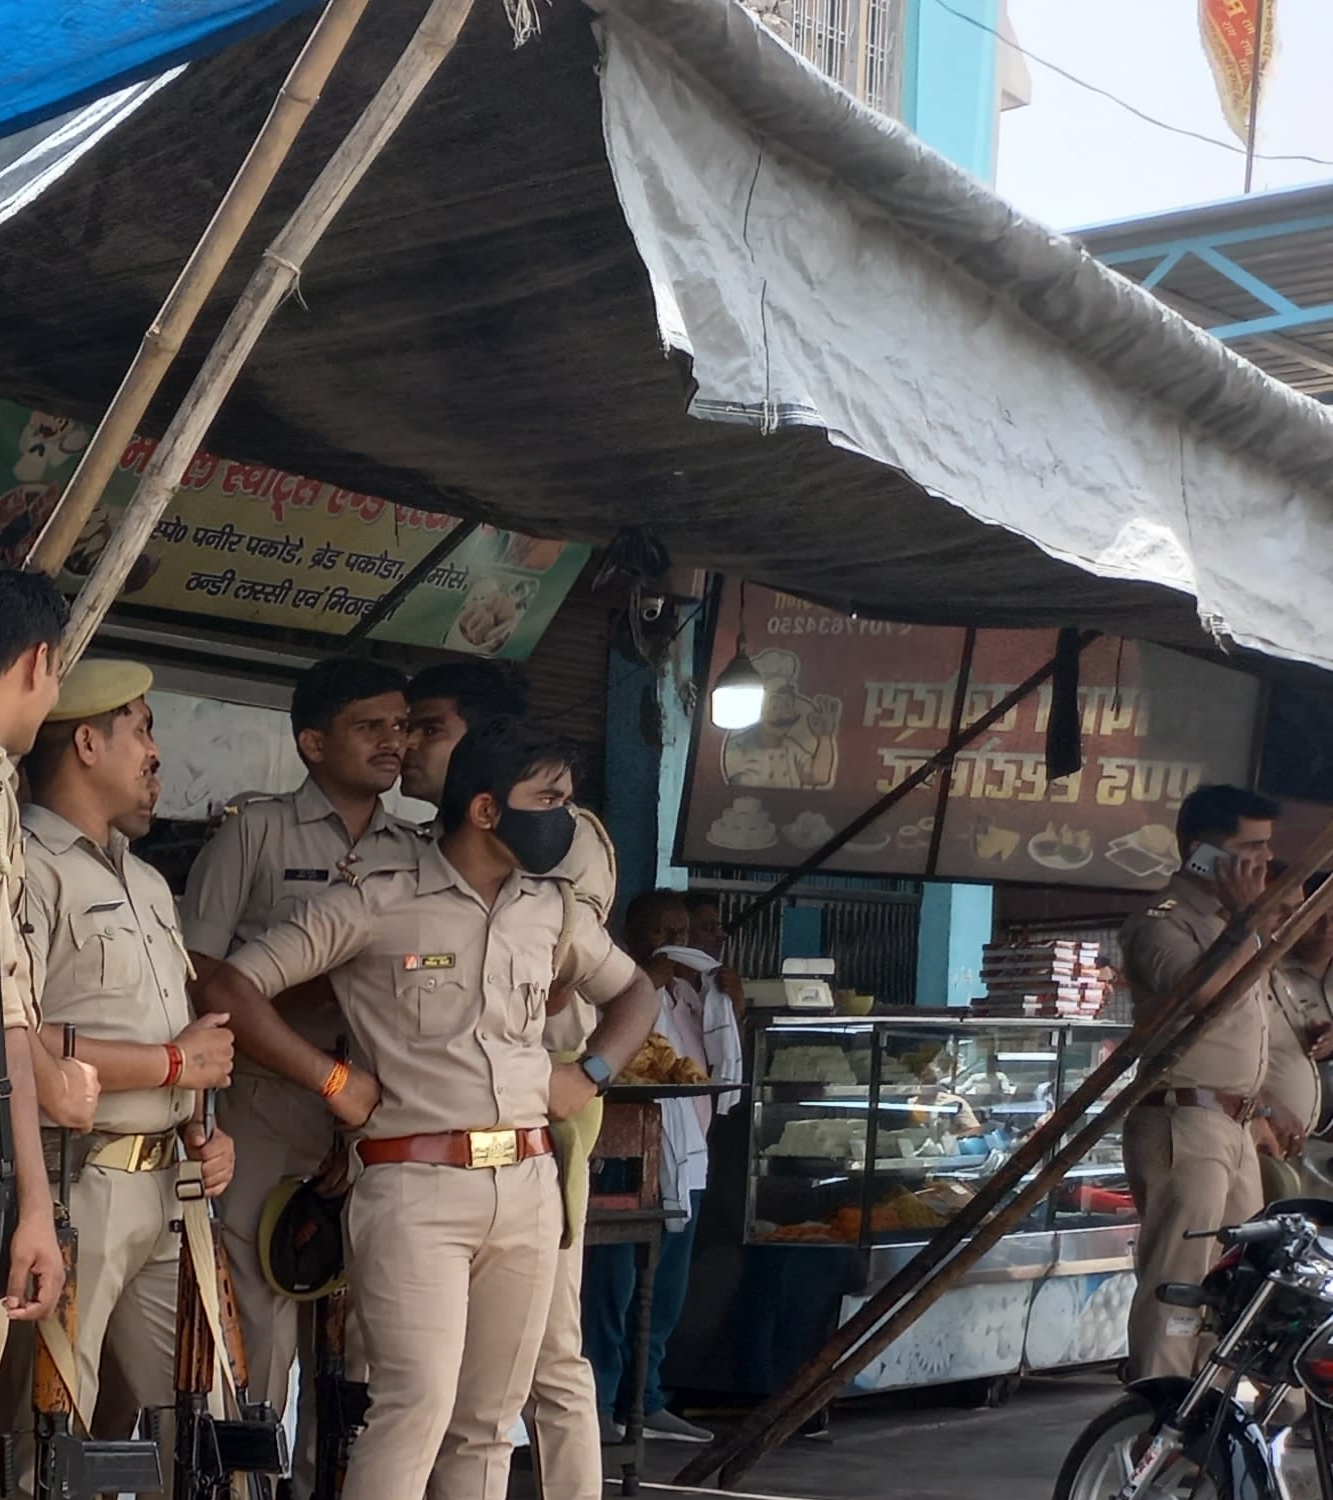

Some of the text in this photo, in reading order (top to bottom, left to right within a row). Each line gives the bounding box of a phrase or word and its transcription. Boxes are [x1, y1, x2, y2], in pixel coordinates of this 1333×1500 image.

[191, 526, 243, 554] पनीर
[309, 541, 347, 570] ब्रेड
[421, 562, 469, 592] मोसे,
[185, 568, 236, 597] ठन्डी
[234, 578, 293, 606] लस्सी
[292, 585, 330, 612] एवं
